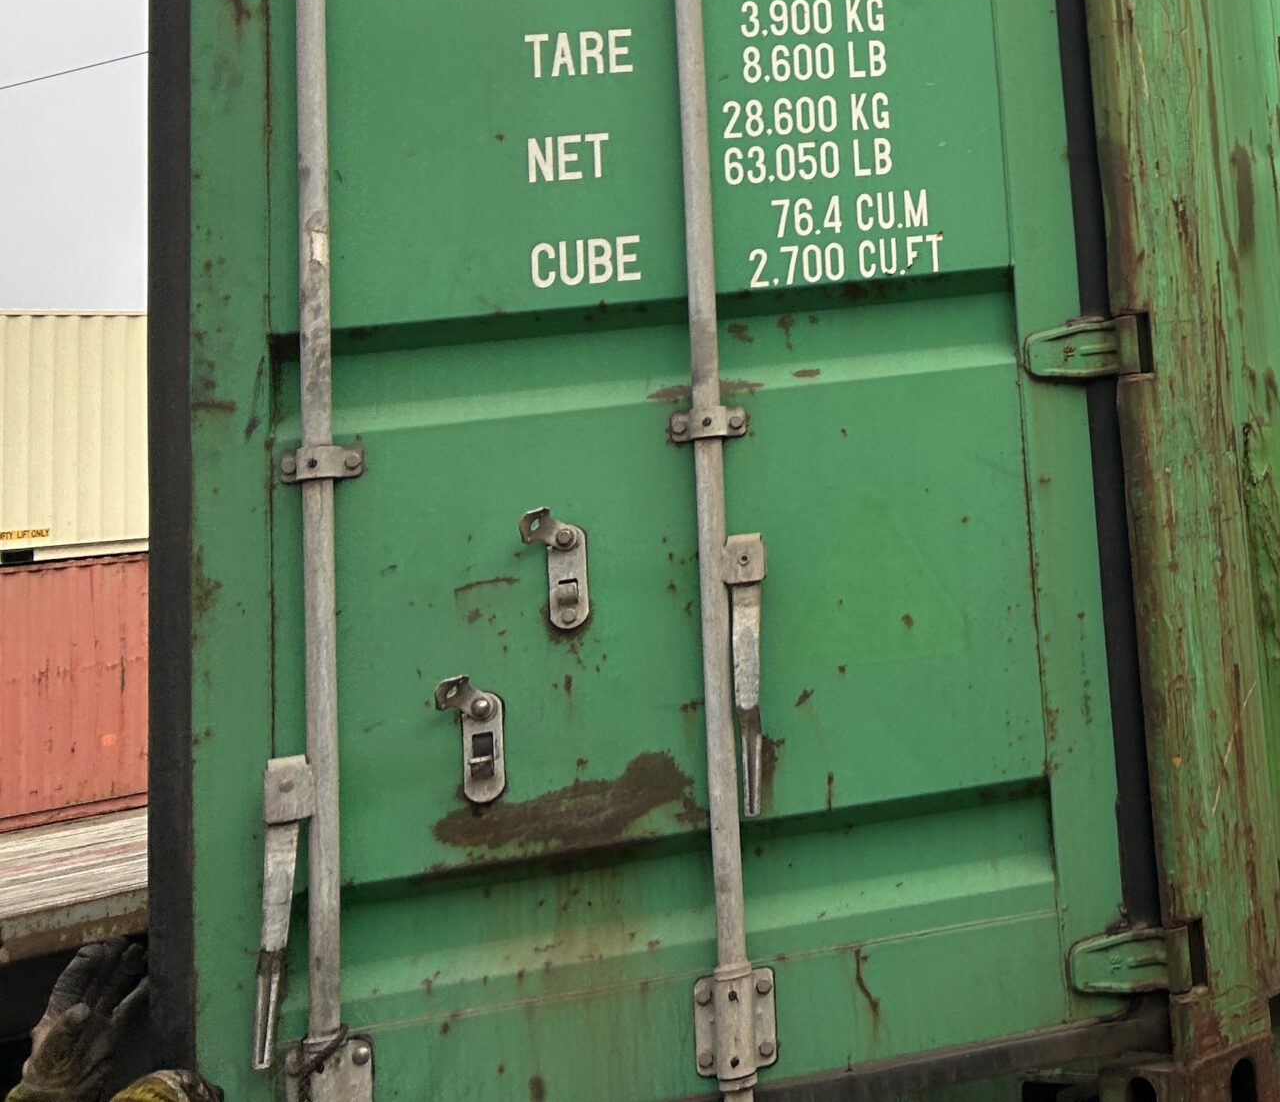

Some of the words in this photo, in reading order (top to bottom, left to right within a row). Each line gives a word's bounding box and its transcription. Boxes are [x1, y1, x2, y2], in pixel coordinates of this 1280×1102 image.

[524, 28, 634, 78] TARE
[847, 40, 887, 78] LB
[850, 92, 890, 131] KG
[527, 132, 609, 183] NET
[853, 137, 893, 177] LB
[771, 195, 842, 238] 76.4
[856, 188, 929, 231] CU.M
[531, 234, 641, 288] CUBE
[858, 233, 943, 278] CU.FT
[31, 528, 50, 538] ONLY
